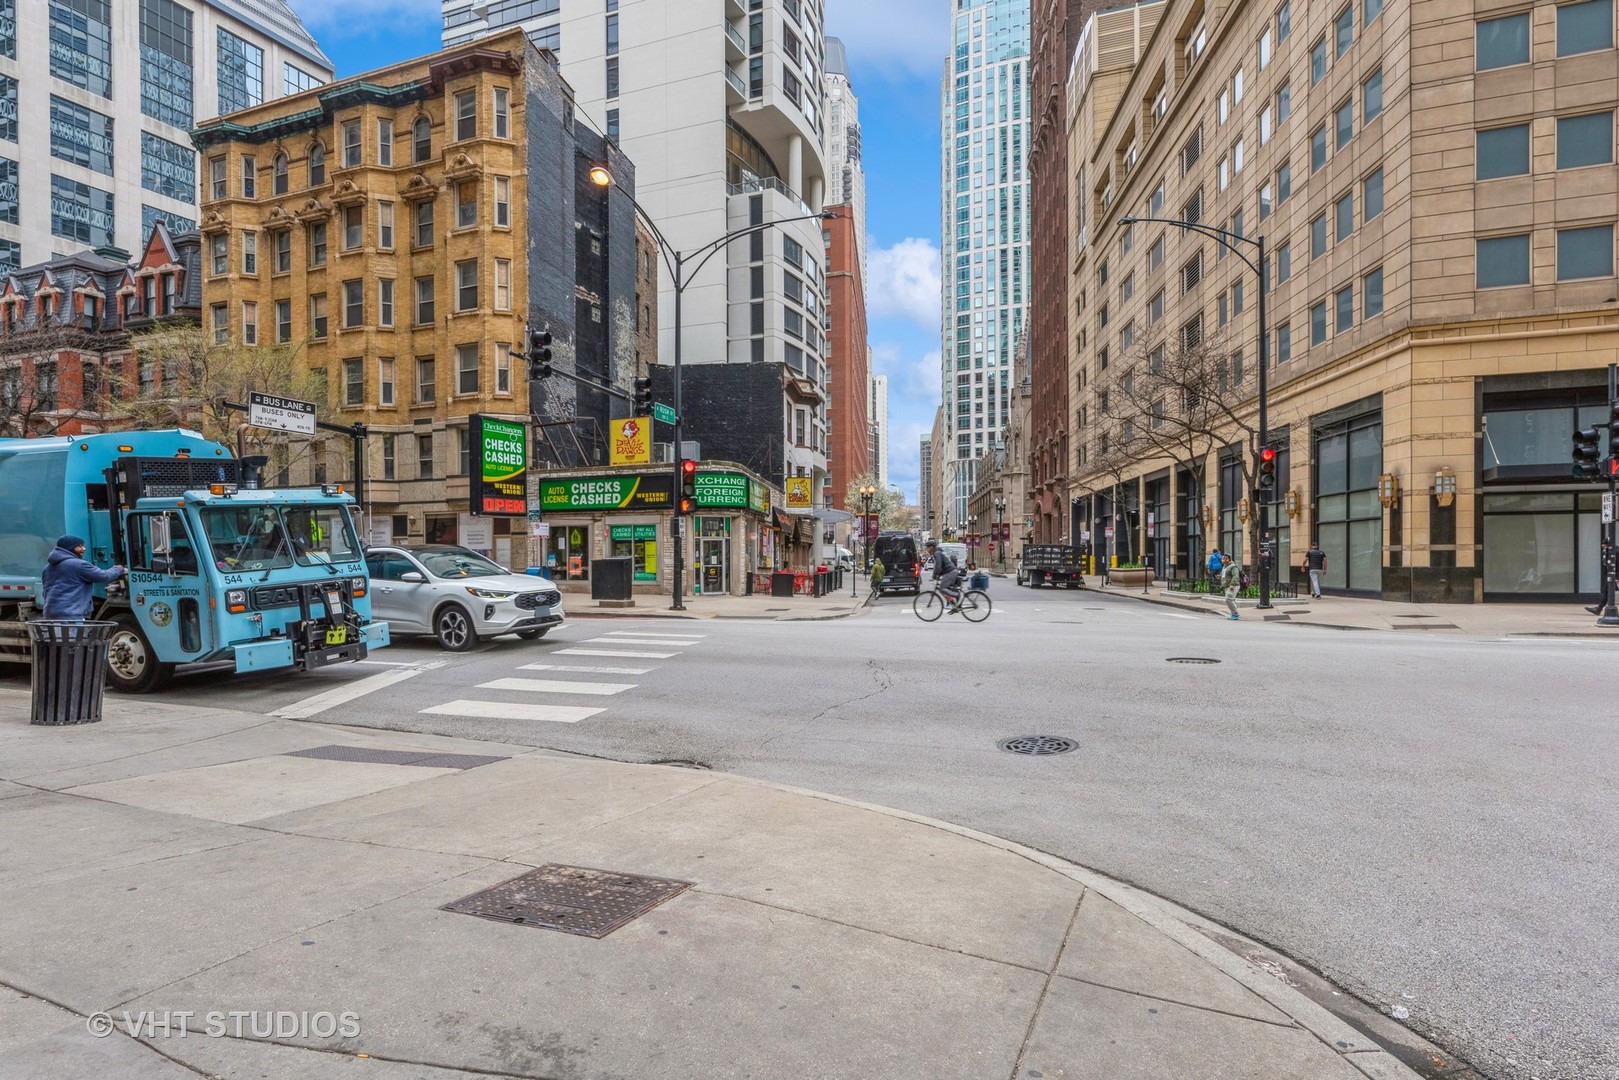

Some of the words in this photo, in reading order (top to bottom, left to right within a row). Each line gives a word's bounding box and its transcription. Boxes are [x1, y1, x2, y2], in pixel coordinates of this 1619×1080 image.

[263, 396, 280, 405] BUS
[282, 400, 304, 411] LANE
[262, 407, 284, 416] BUSES
[287, 412, 305, 420] ONLY
[485, 438, 522, 454] CHECKS
[485, 451, 522, 466] CASHED
[571, 481, 620, 494] CHECKS
[484, 497, 525, 513] OPEN
[544, 495, 568, 504] LICENSE
[571, 493, 621, 505] CASHED
[347, 564, 362, 573] 544
[131, 573, 163, 583] S10544
[224, 575, 243, 584] 544
[143, 588, 165, 597] STREETS
